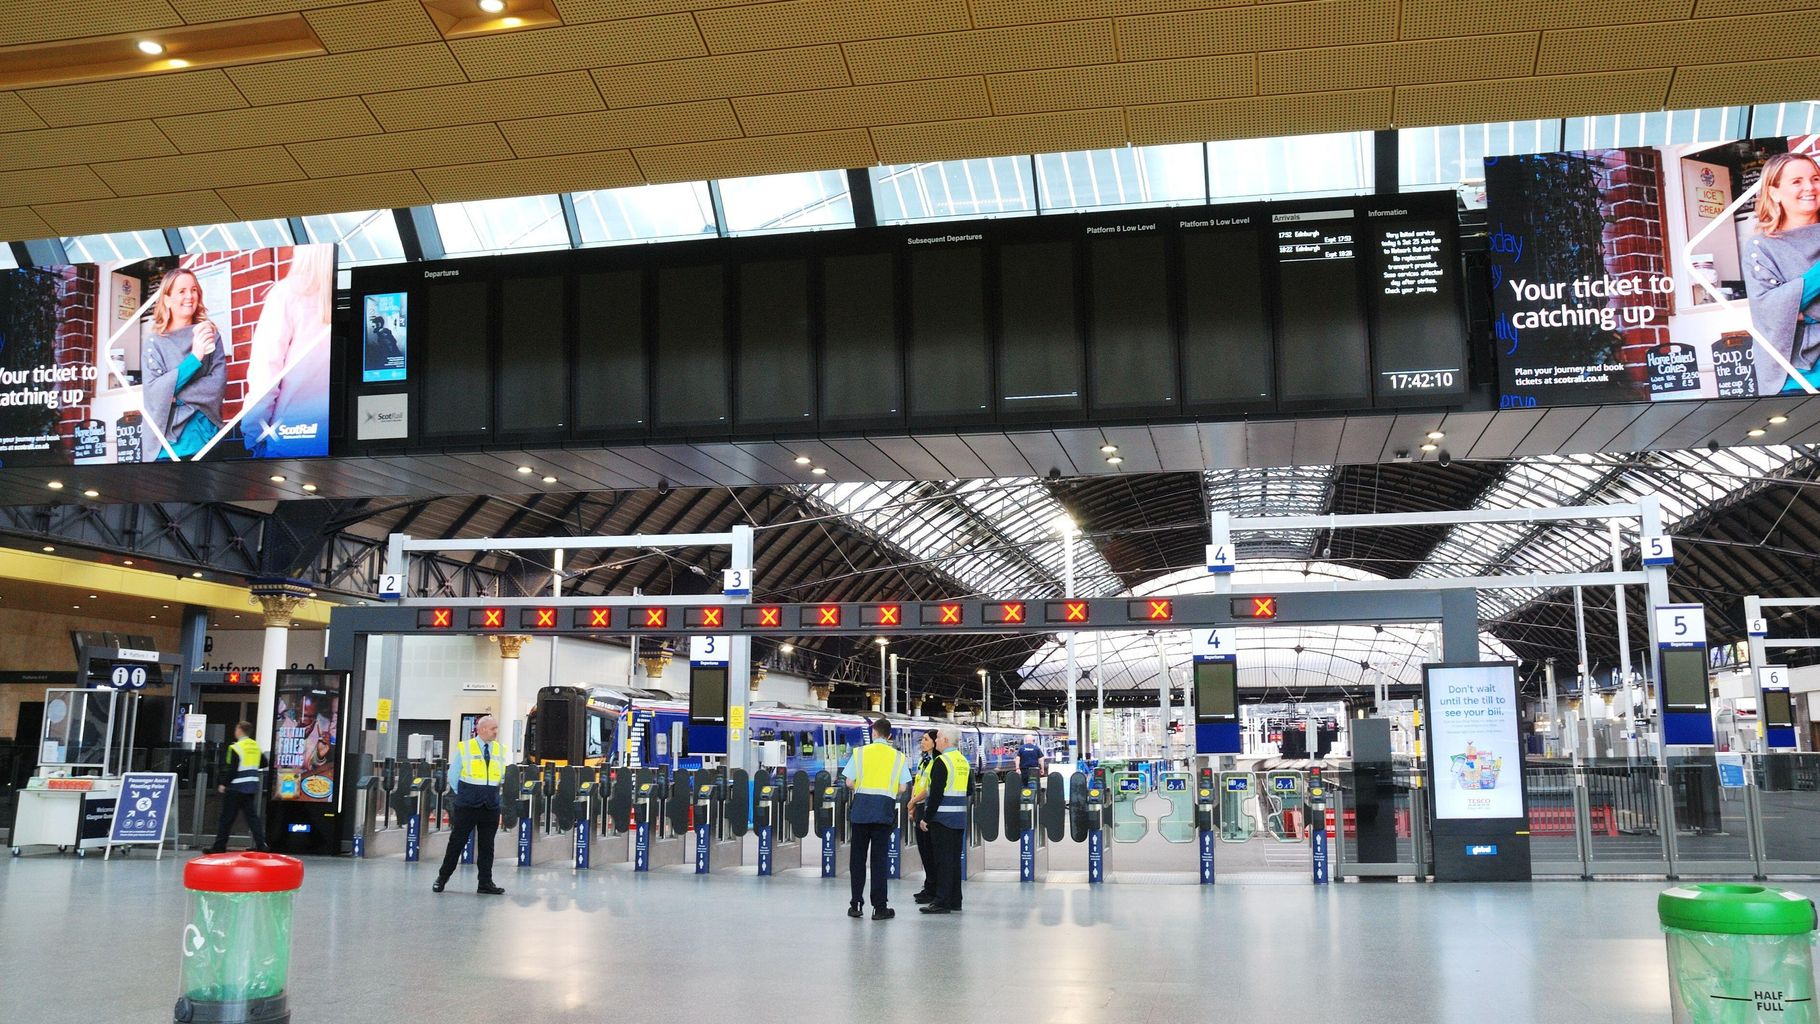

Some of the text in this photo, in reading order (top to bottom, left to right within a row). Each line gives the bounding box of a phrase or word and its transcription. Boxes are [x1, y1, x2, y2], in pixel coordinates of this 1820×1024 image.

[1703, 190, 1717, 200] ICE
[1368, 209, 1408, 217] Information
[1086, 226, 1115, 234] Platform
[1122, 224, 1137, 232] Low
[1137, 223, 1156, 231] Level
[1180, 220, 1209, 228] Platform
[1215, 218, 1231, 226] Low
[1231, 217, 1250, 225] Level
[907, 234, 983, 245] Subsequent Departures
[1294, 230, 1320, 238] Edinburgh
[424, 270, 460, 279] Departures
[1509, 274, 1675, 302] Your ticket to
[1512, 303, 1656, 331] catching up
[1713, 350, 1742, 366] Soup
[33, 364, 78, 383] ticket
[81, 366, 98, 380] to
[1515, 362, 1624, 377] Plan your journey and book
[1658, 363, 1688, 375] Cakes
[1717, 363, 1751, 381] the day
[1390, 372, 1453, 389] 17:42:10
[1515, 377, 1542, 386] tickets
[1553, 374, 1609, 384] scotrail.co.uk
[62, 389, 84, 407] up
[377, 411, 403, 420] ScotRail
[278, 423, 318, 436] ScotRail
[1651, 538, 1663, 556] 5
[1215, 546, 1227, 564] 4
[386, 575, 394, 591] 2
[732, 571, 742, 588] 3
[1674, 615, 1687, 636] 5
[1753, 619, 1761, 631] 6
[704, 636, 715, 654] 3
[1207, 629, 1221, 649] 4
[1770, 671, 1779, 684] 6
[1448, 684, 1496, 694] Don't wait
[1440, 697, 1461, 706] until
[1463, 697, 1479, 705] the
[1481, 696, 1493, 704] till
[1464, 709, 1486, 718] your
[1487, 708, 1504, 716] bill.
[278, 738, 306, 754] FRIES
[277, 754, 304, 766] FEELING
[1754, 991, 1783, 1000] HALF
[1757, 1002, 1784, 1011] FULL
